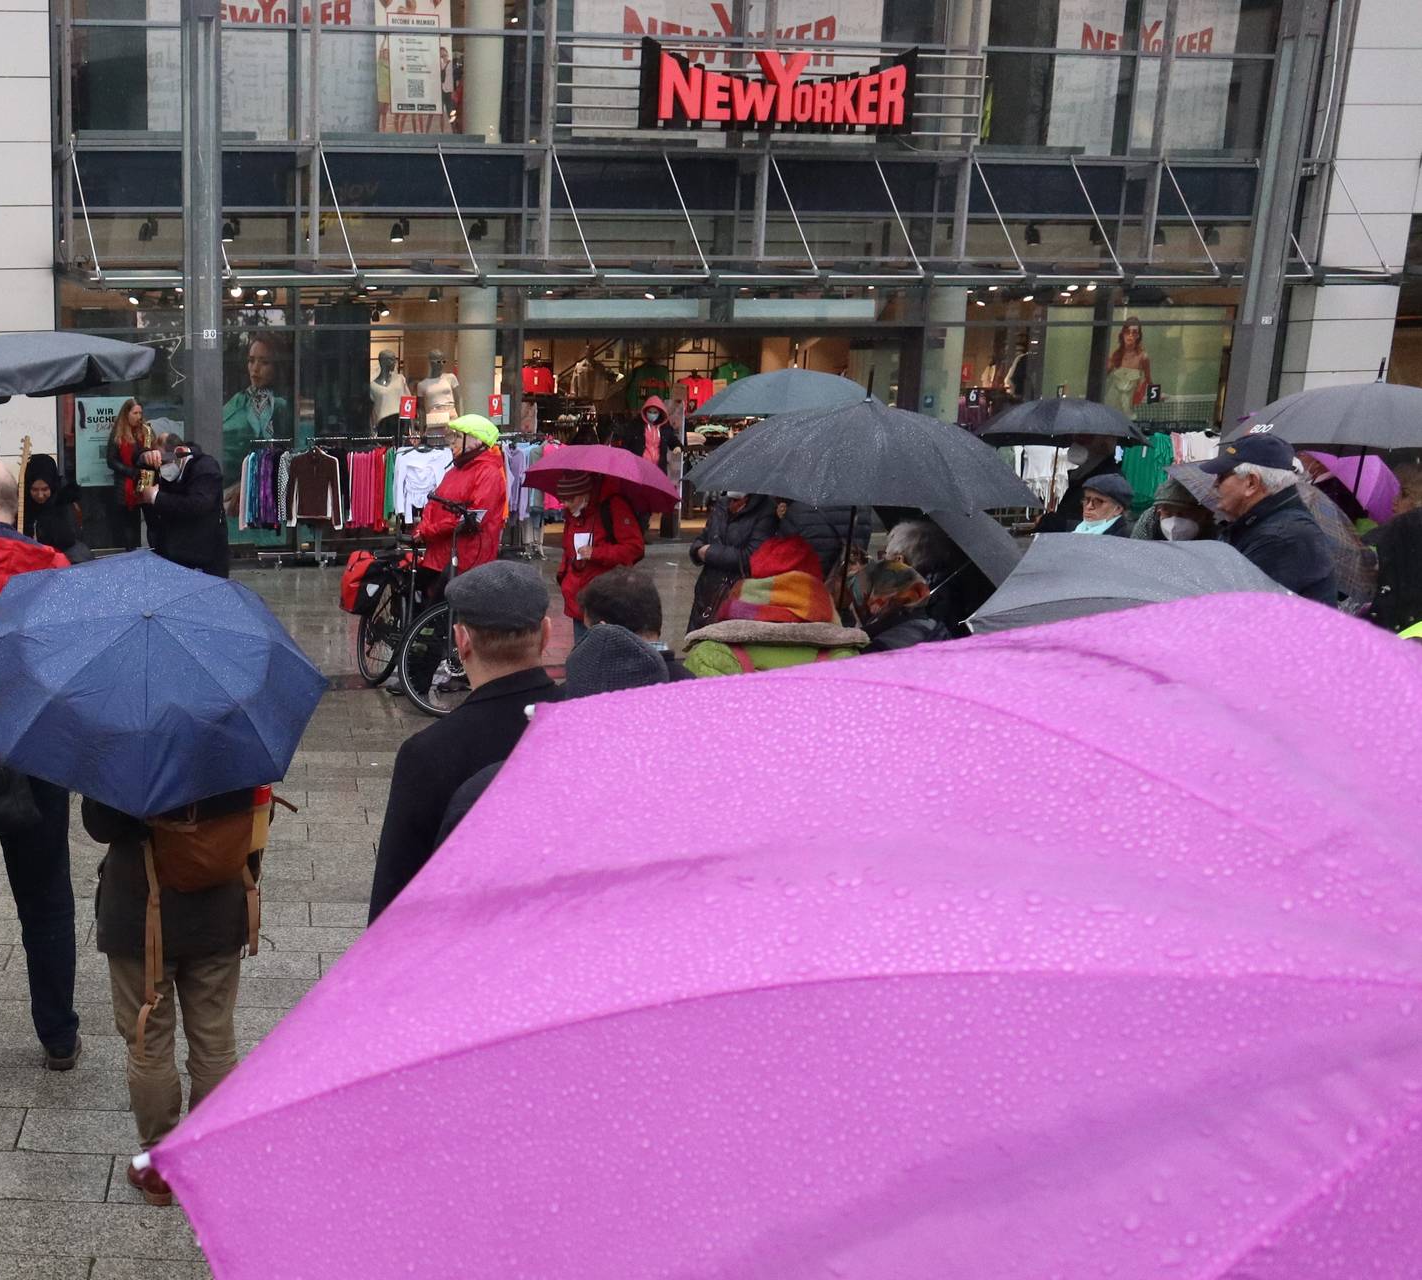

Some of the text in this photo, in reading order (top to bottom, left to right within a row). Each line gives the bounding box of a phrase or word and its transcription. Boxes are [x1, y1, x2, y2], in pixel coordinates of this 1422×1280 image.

[658, 50, 908, 126] NEWYORKER
[205, 330, 216, 338] 30
[1150, 387, 1158, 399] 5
[96, 407, 114, 415] WIR
[86, 415, 116, 424] SUCHE
